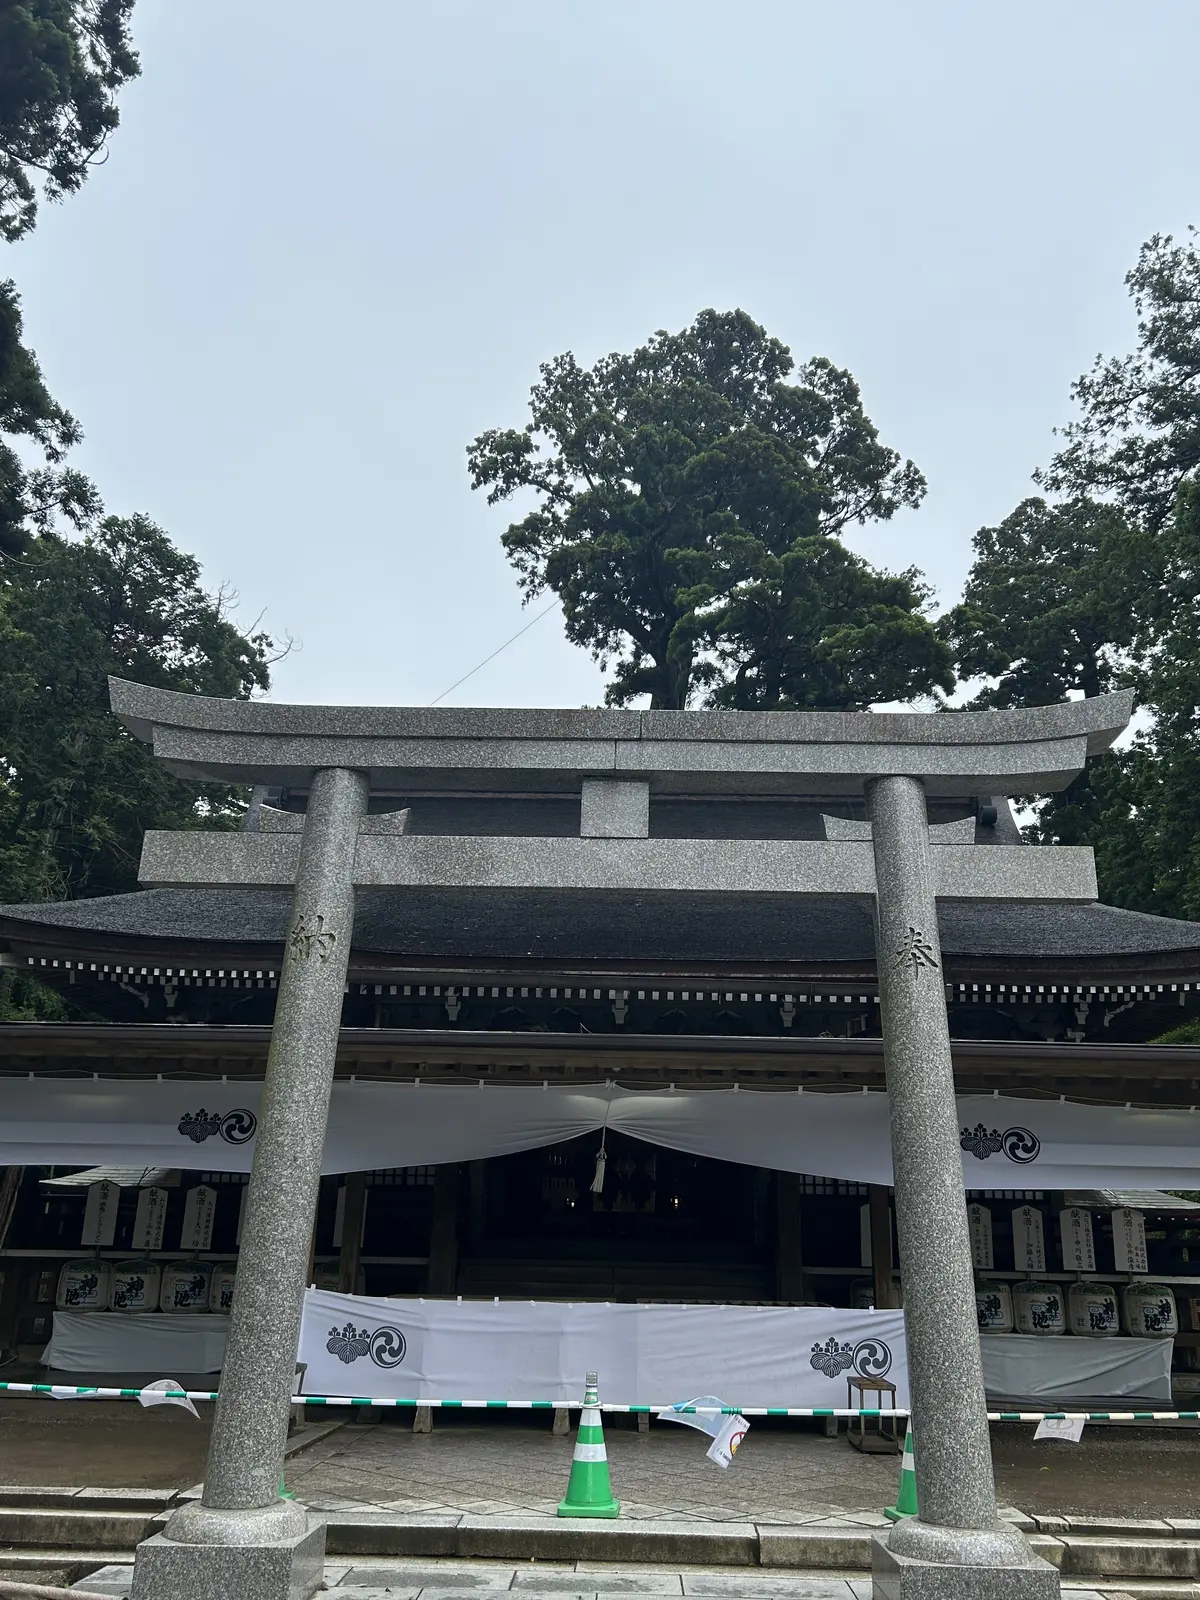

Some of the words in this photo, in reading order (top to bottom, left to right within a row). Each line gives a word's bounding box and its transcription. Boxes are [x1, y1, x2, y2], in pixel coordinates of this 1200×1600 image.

[892, 927, 938, 981] 奉
[148, 1188, 159, 1206] 献酒
[196, 1188, 207, 1206] 献酒
[1022, 1208, 1033, 1226] 献酒
[1071, 1209, 1081, 1227] 献酒
[1123, 1210, 1133, 1228] 献酒
